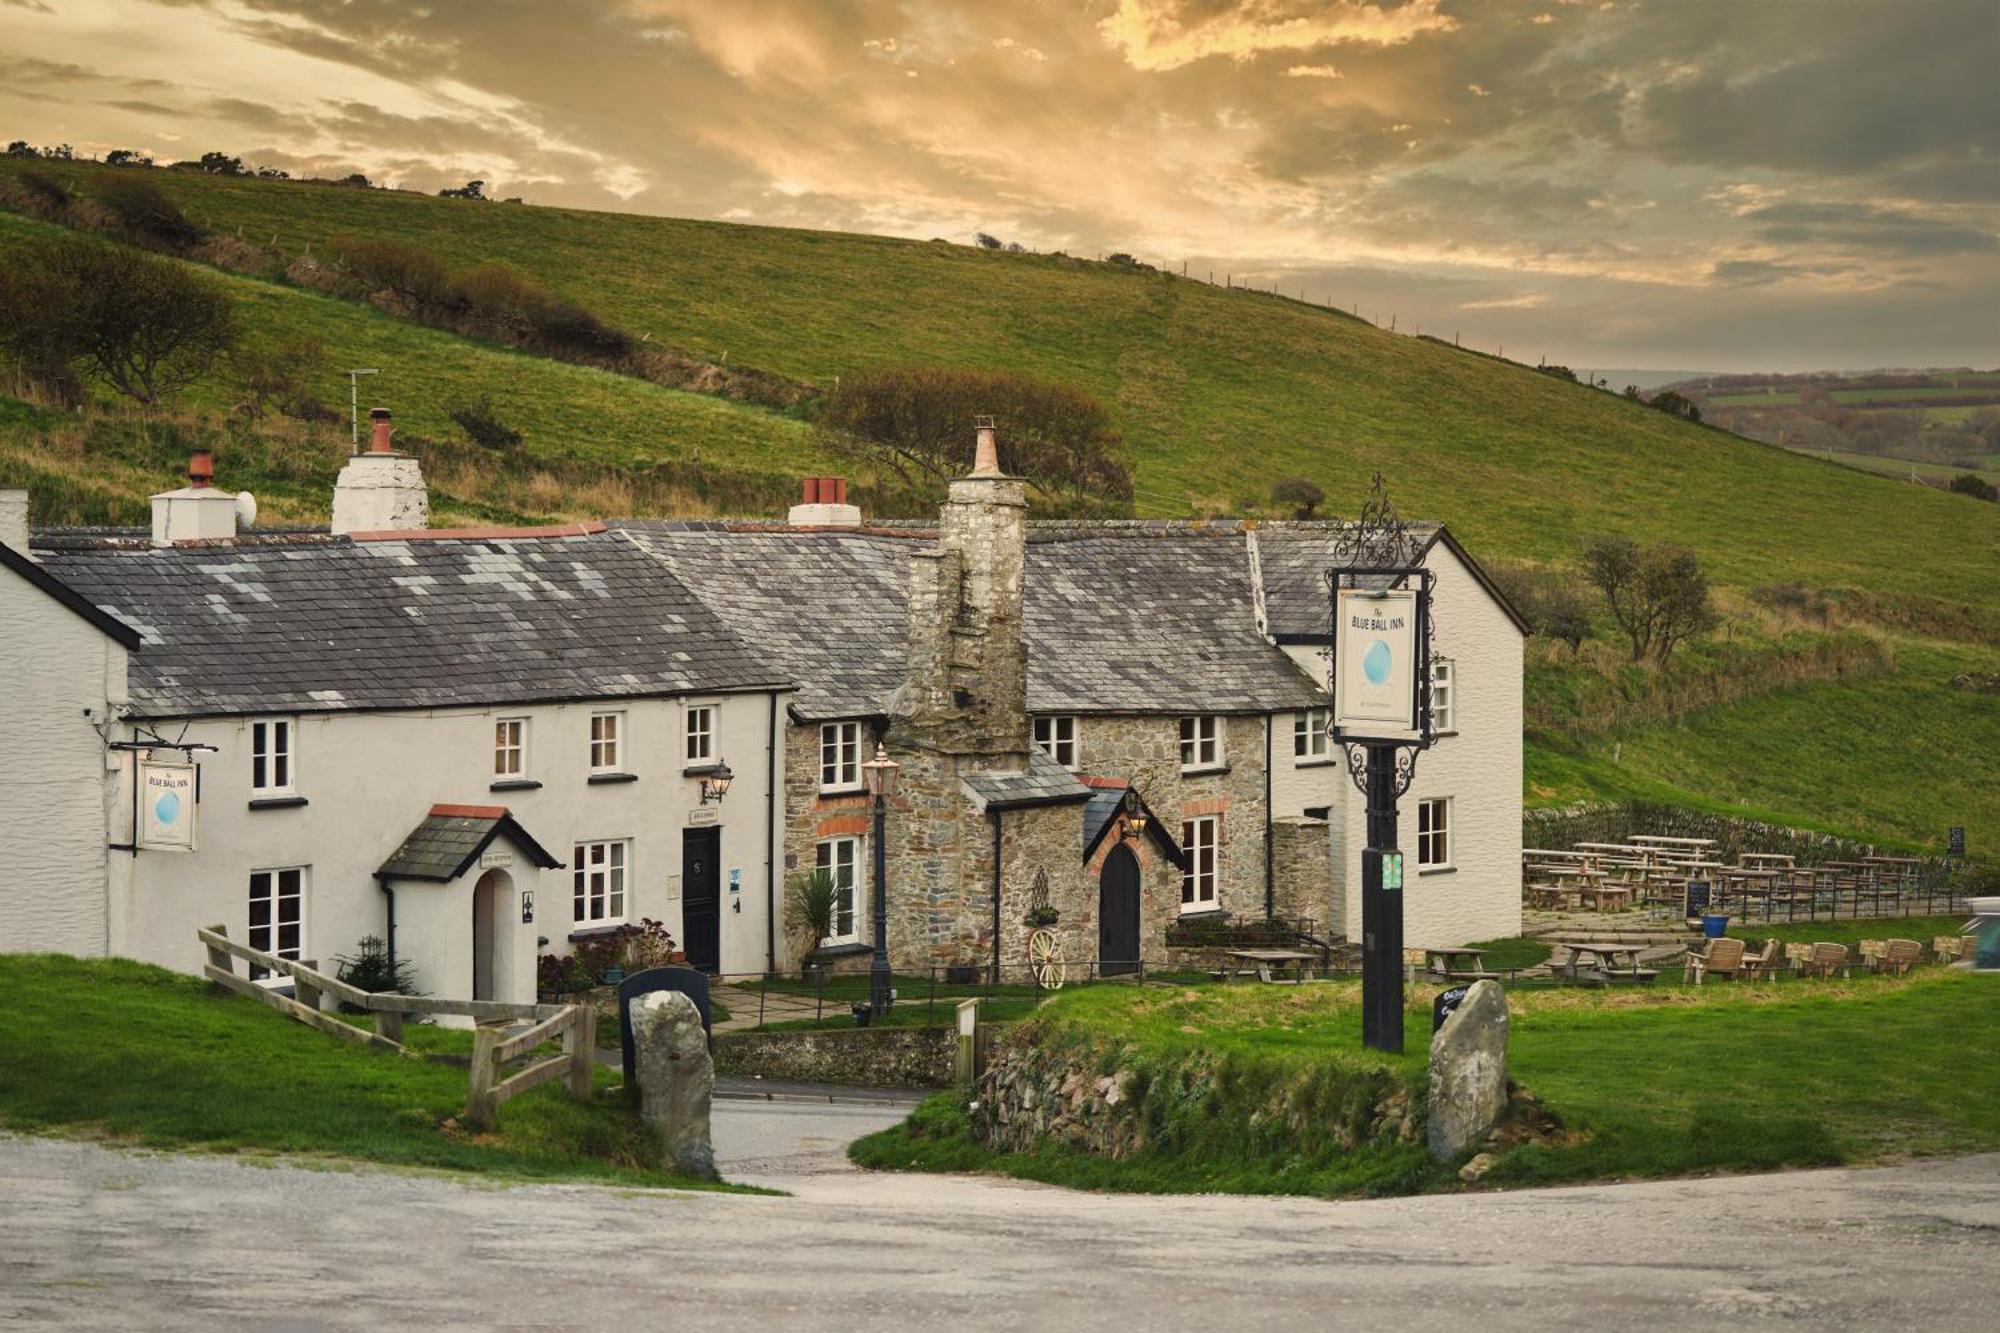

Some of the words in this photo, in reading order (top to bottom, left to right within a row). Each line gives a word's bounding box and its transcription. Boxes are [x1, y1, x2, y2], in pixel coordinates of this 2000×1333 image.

[1351, 616, 1369, 630] BLUE
[1371, 619, 1388, 631] BALL
[1390, 617, 1404, 630] INN
